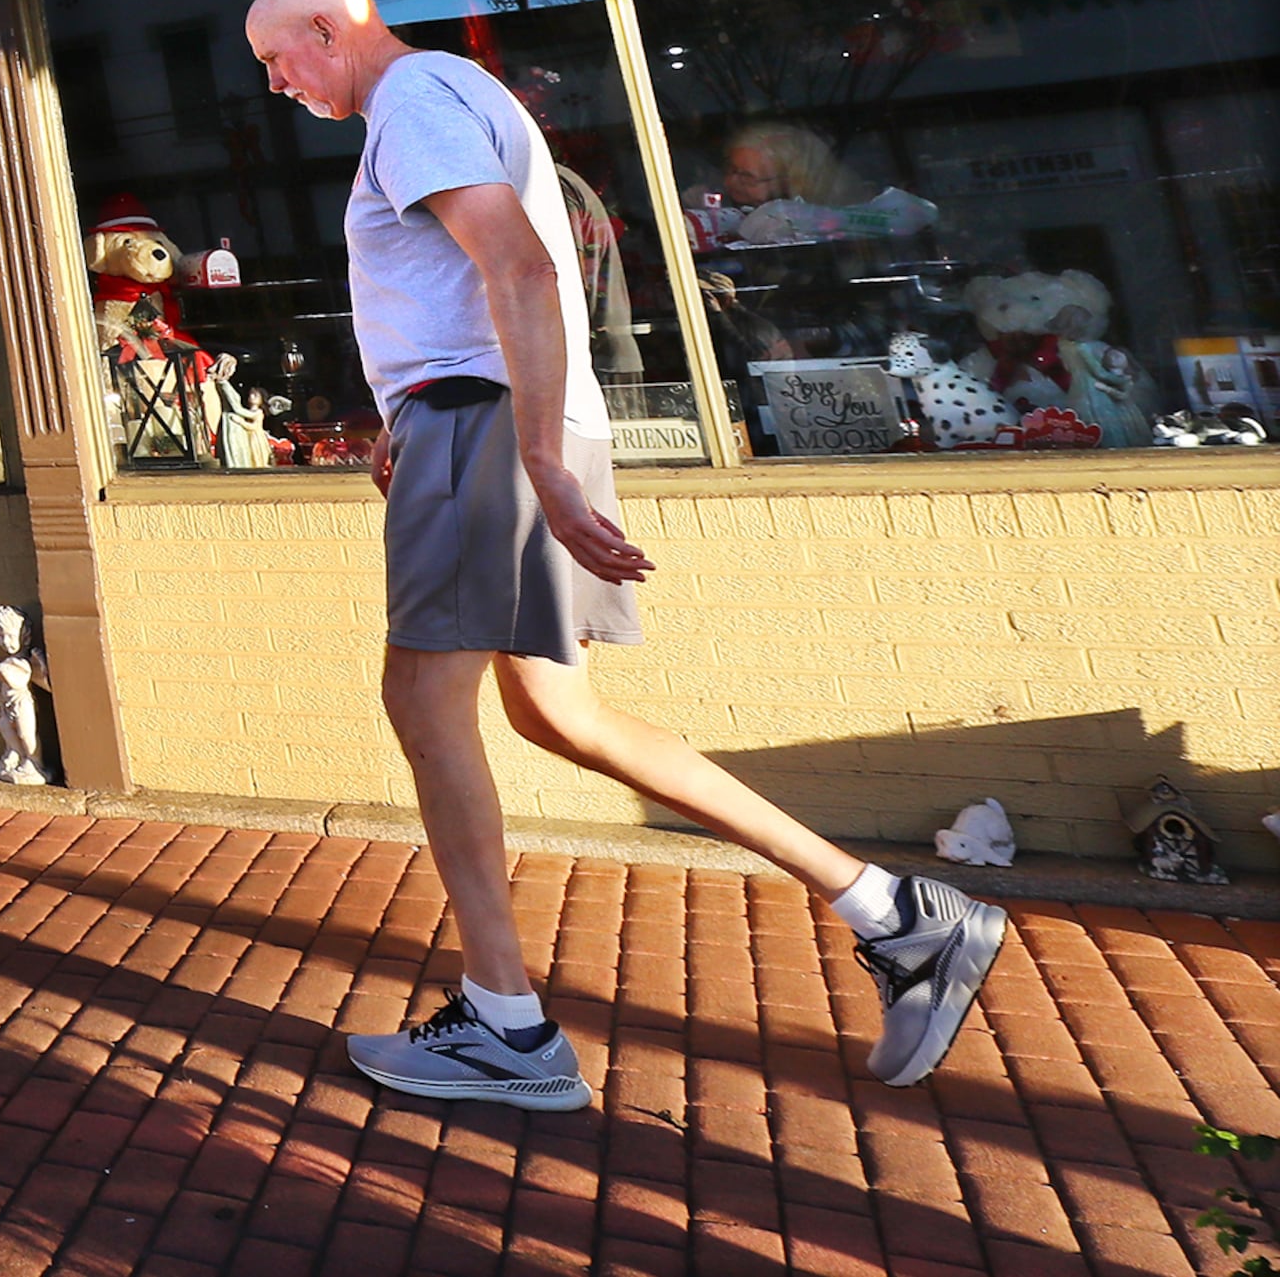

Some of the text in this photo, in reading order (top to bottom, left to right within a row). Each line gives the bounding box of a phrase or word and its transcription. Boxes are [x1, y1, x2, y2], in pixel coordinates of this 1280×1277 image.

[780, 374, 840, 404] Love
[814, 393, 882, 427] You
[611, 427, 698, 449] FRIENDS
[790, 428, 889, 449] MOON
